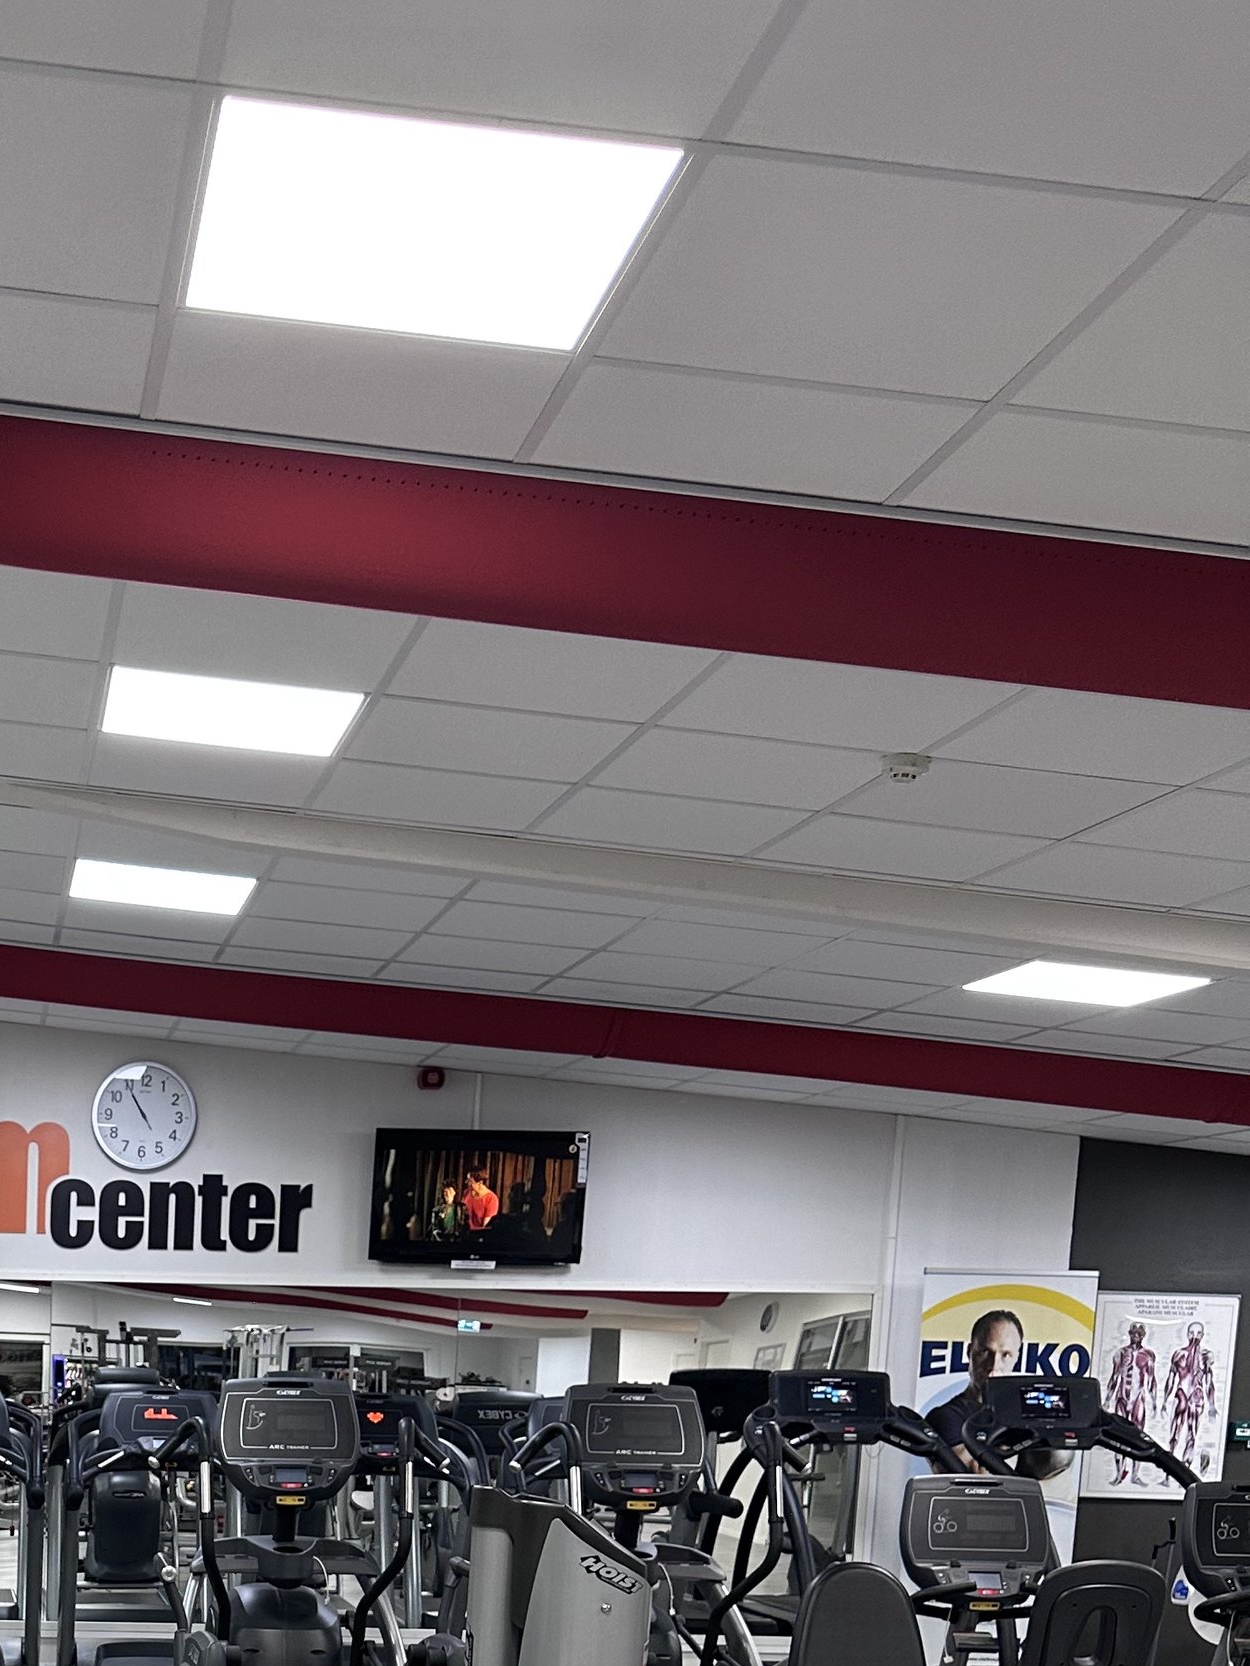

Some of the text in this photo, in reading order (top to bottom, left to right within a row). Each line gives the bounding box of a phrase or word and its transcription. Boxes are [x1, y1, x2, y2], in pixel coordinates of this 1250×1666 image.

[141, 1074, 152, 1088] 12
[161, 1080, 166, 1093] 1
[110, 1090, 122, 1103] 10
[171, 1093, 180, 1106] 2
[104, 1107, 113, 1120] 9
[174, 1111, 184, 1124] 3
[109, 1126, 118, 1139] 8
[168, 1129, 177, 1141] 4
[121, 1140, 130, 1152] 7
[137, 1145, 146, 1158] 6
[154, 1141, 164, 1154] 5
[50, 1173, 313, 1253] center
[579, 1557, 642, 1593] HOIST
